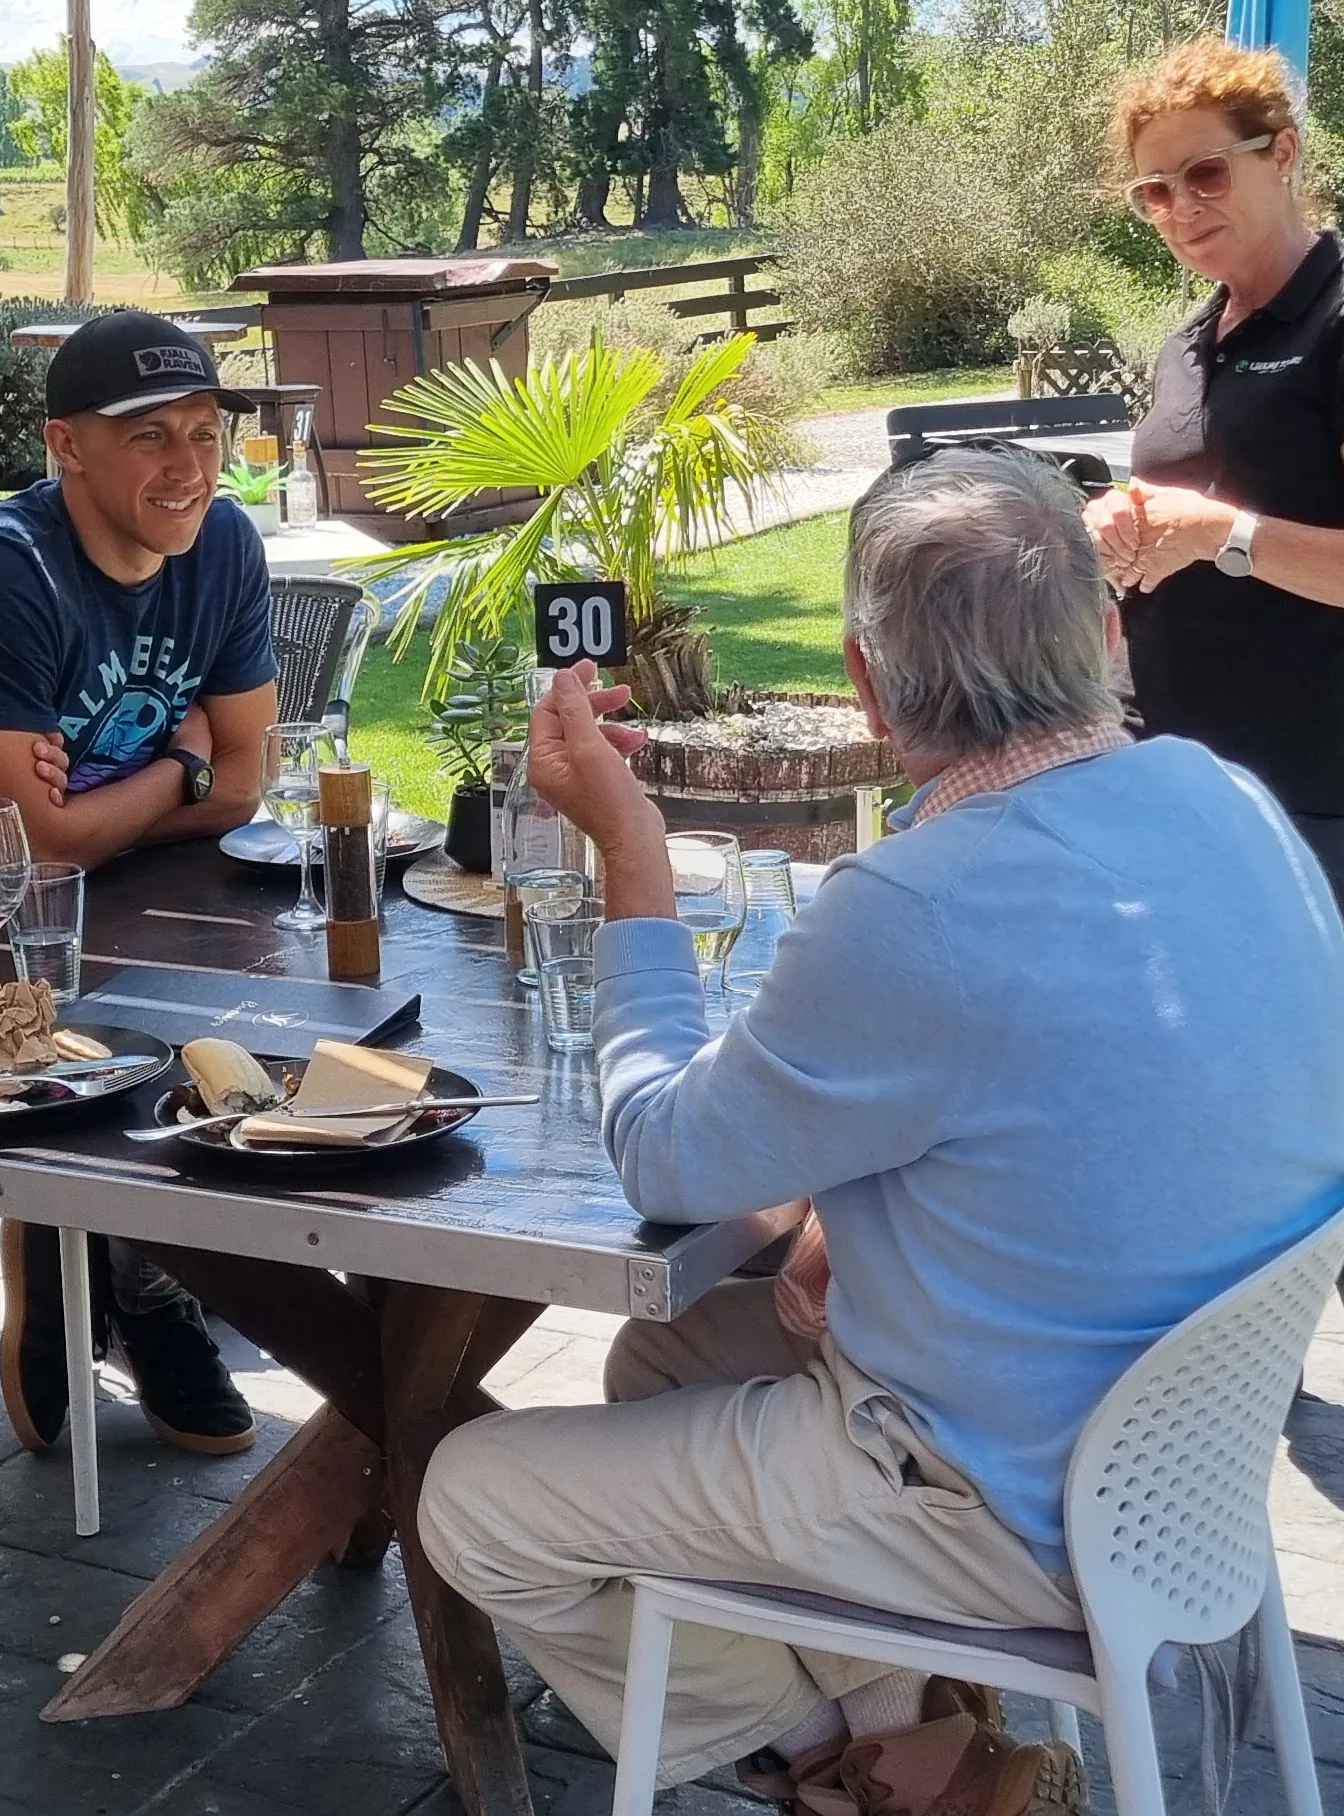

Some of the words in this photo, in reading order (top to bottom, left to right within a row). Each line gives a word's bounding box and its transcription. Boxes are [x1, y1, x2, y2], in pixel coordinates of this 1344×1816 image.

[160, 349, 191, 361] FJALL
[163, 358, 203, 374] RAVEN
[293, 410, 311, 442] 31
[548, 595, 613, 658] 30
[57, 649, 128, 742] ALM
